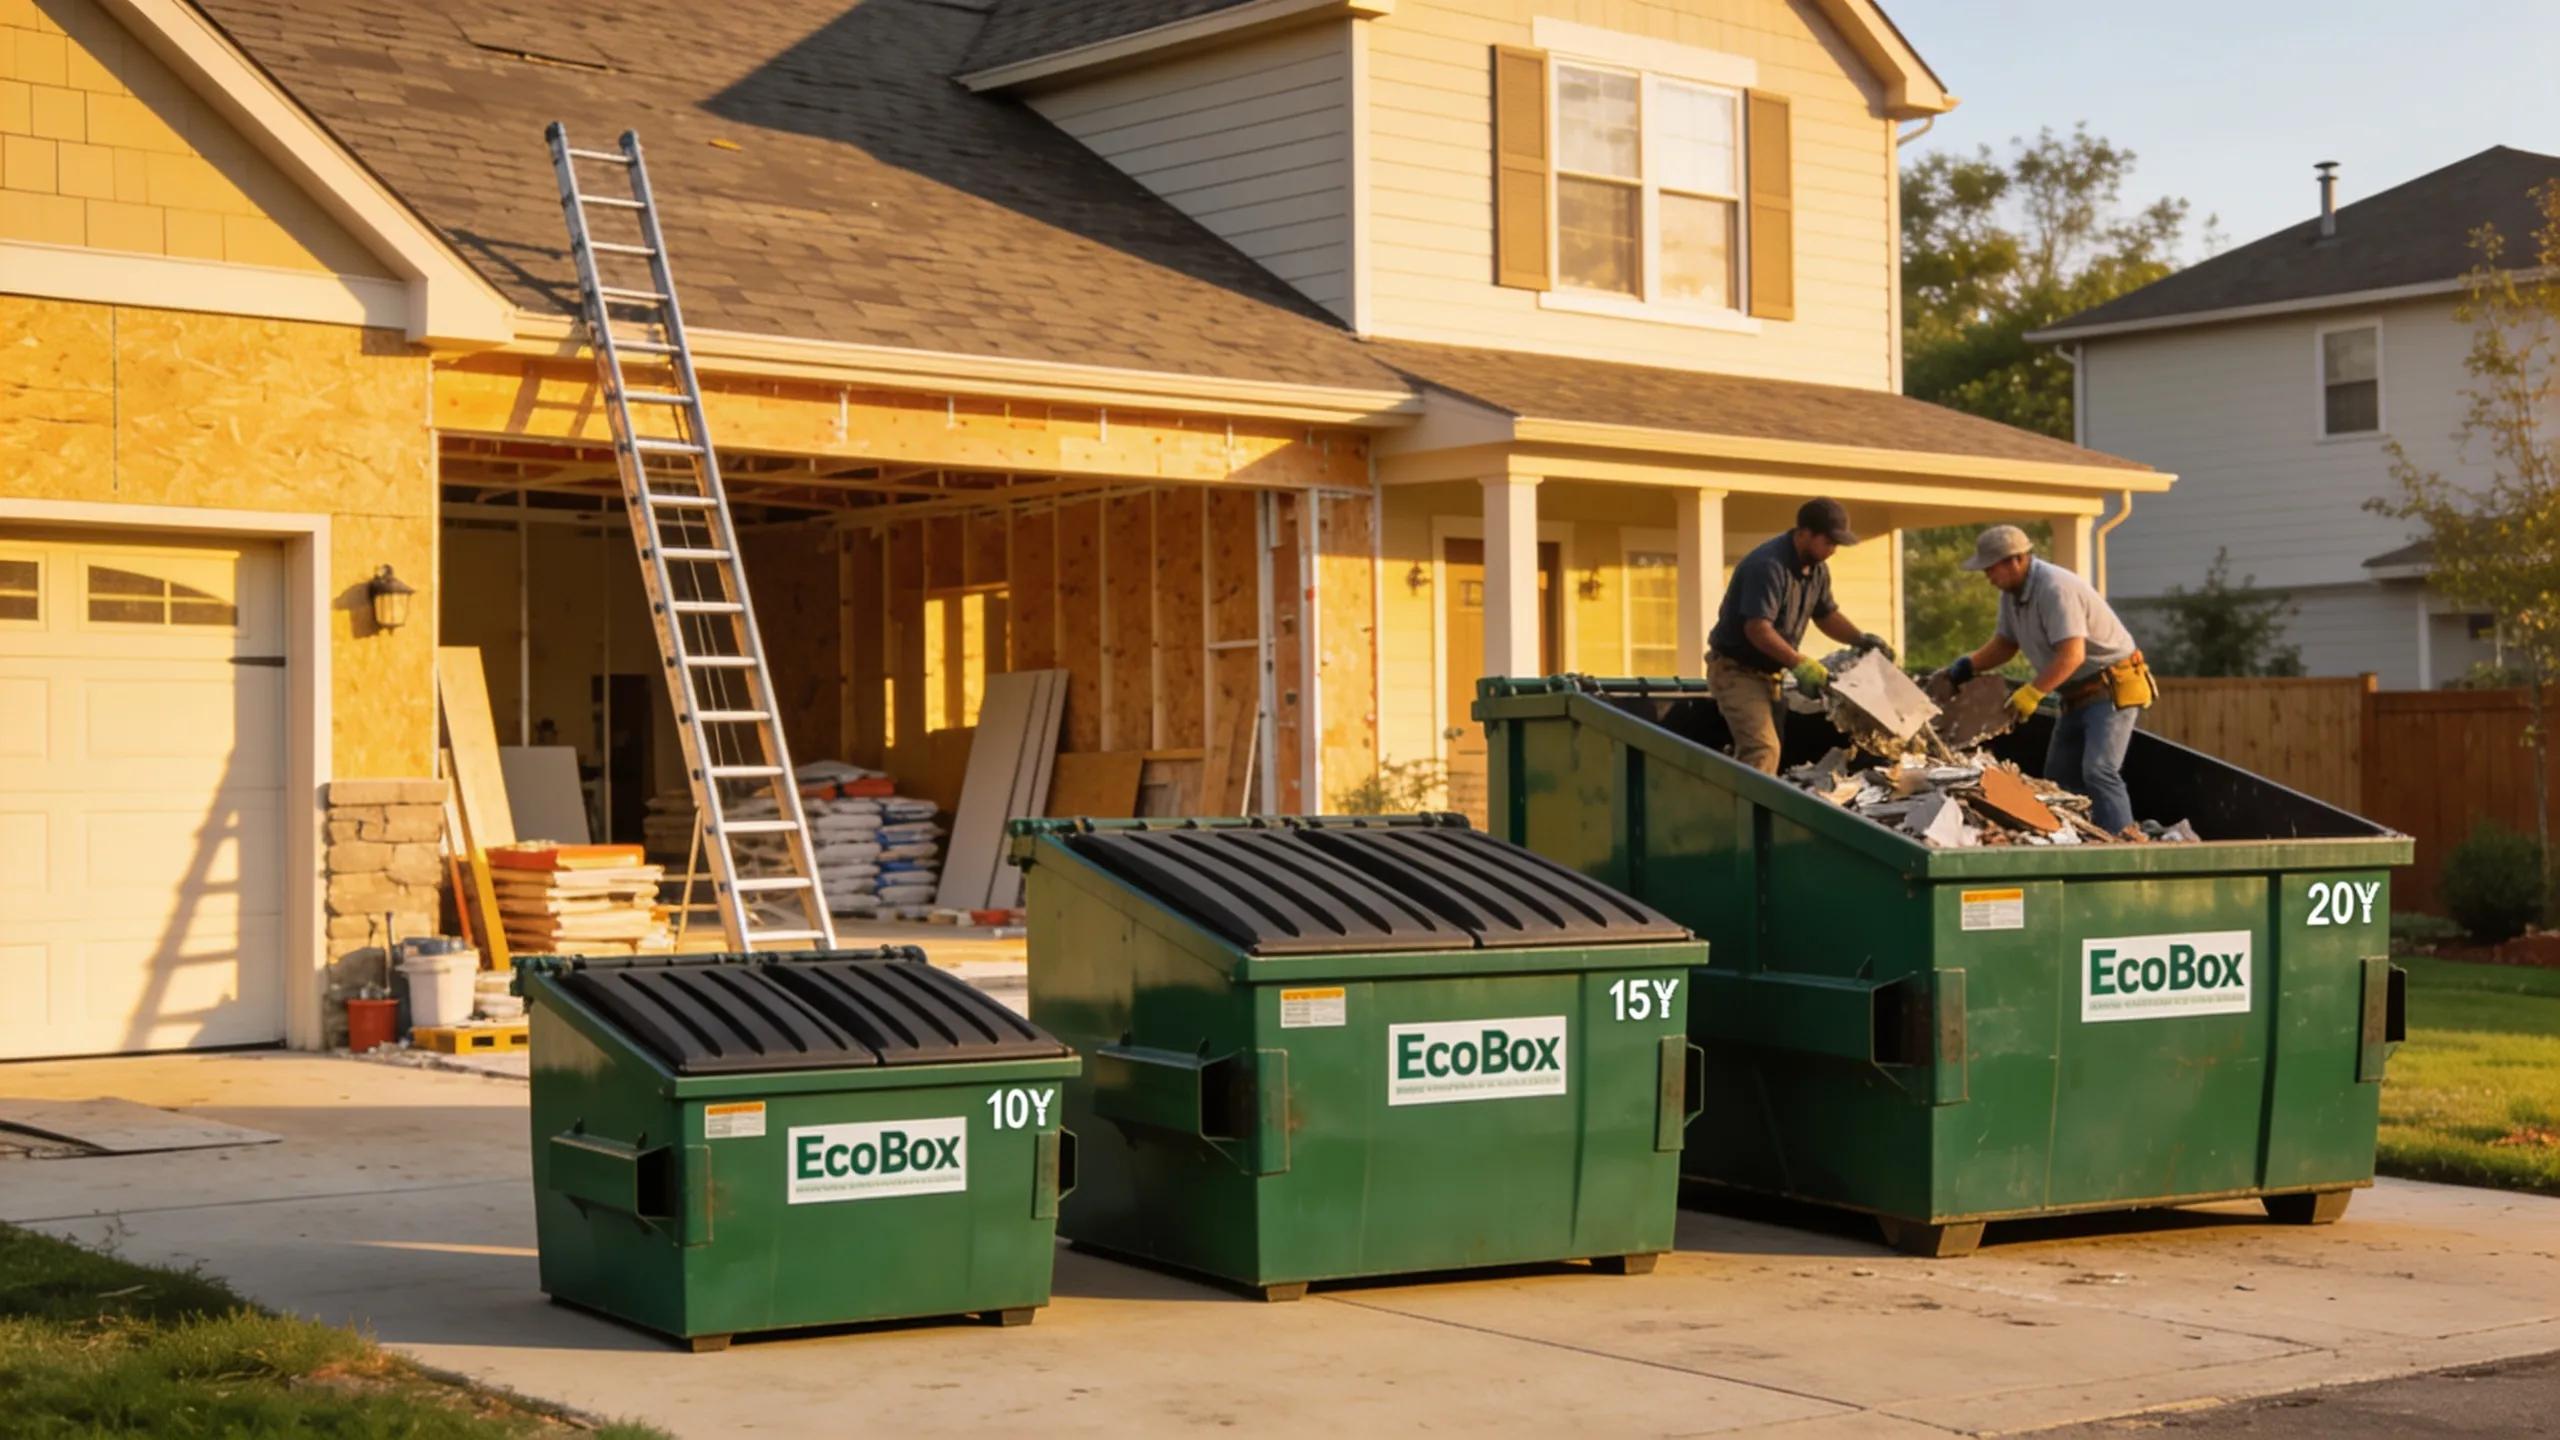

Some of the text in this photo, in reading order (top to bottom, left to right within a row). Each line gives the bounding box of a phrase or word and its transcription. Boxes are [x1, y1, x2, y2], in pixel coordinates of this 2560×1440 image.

[2306, 881, 2380, 926] 20Y
[2090, 944, 2244, 996] EcoBox
[1609, 978, 1680, 1021] 15Y
[1397, 1029, 1561, 1080] EcoBox
[986, 1088, 1055, 1130] 10Y
[796, 1131, 961, 1180] EcoBox
